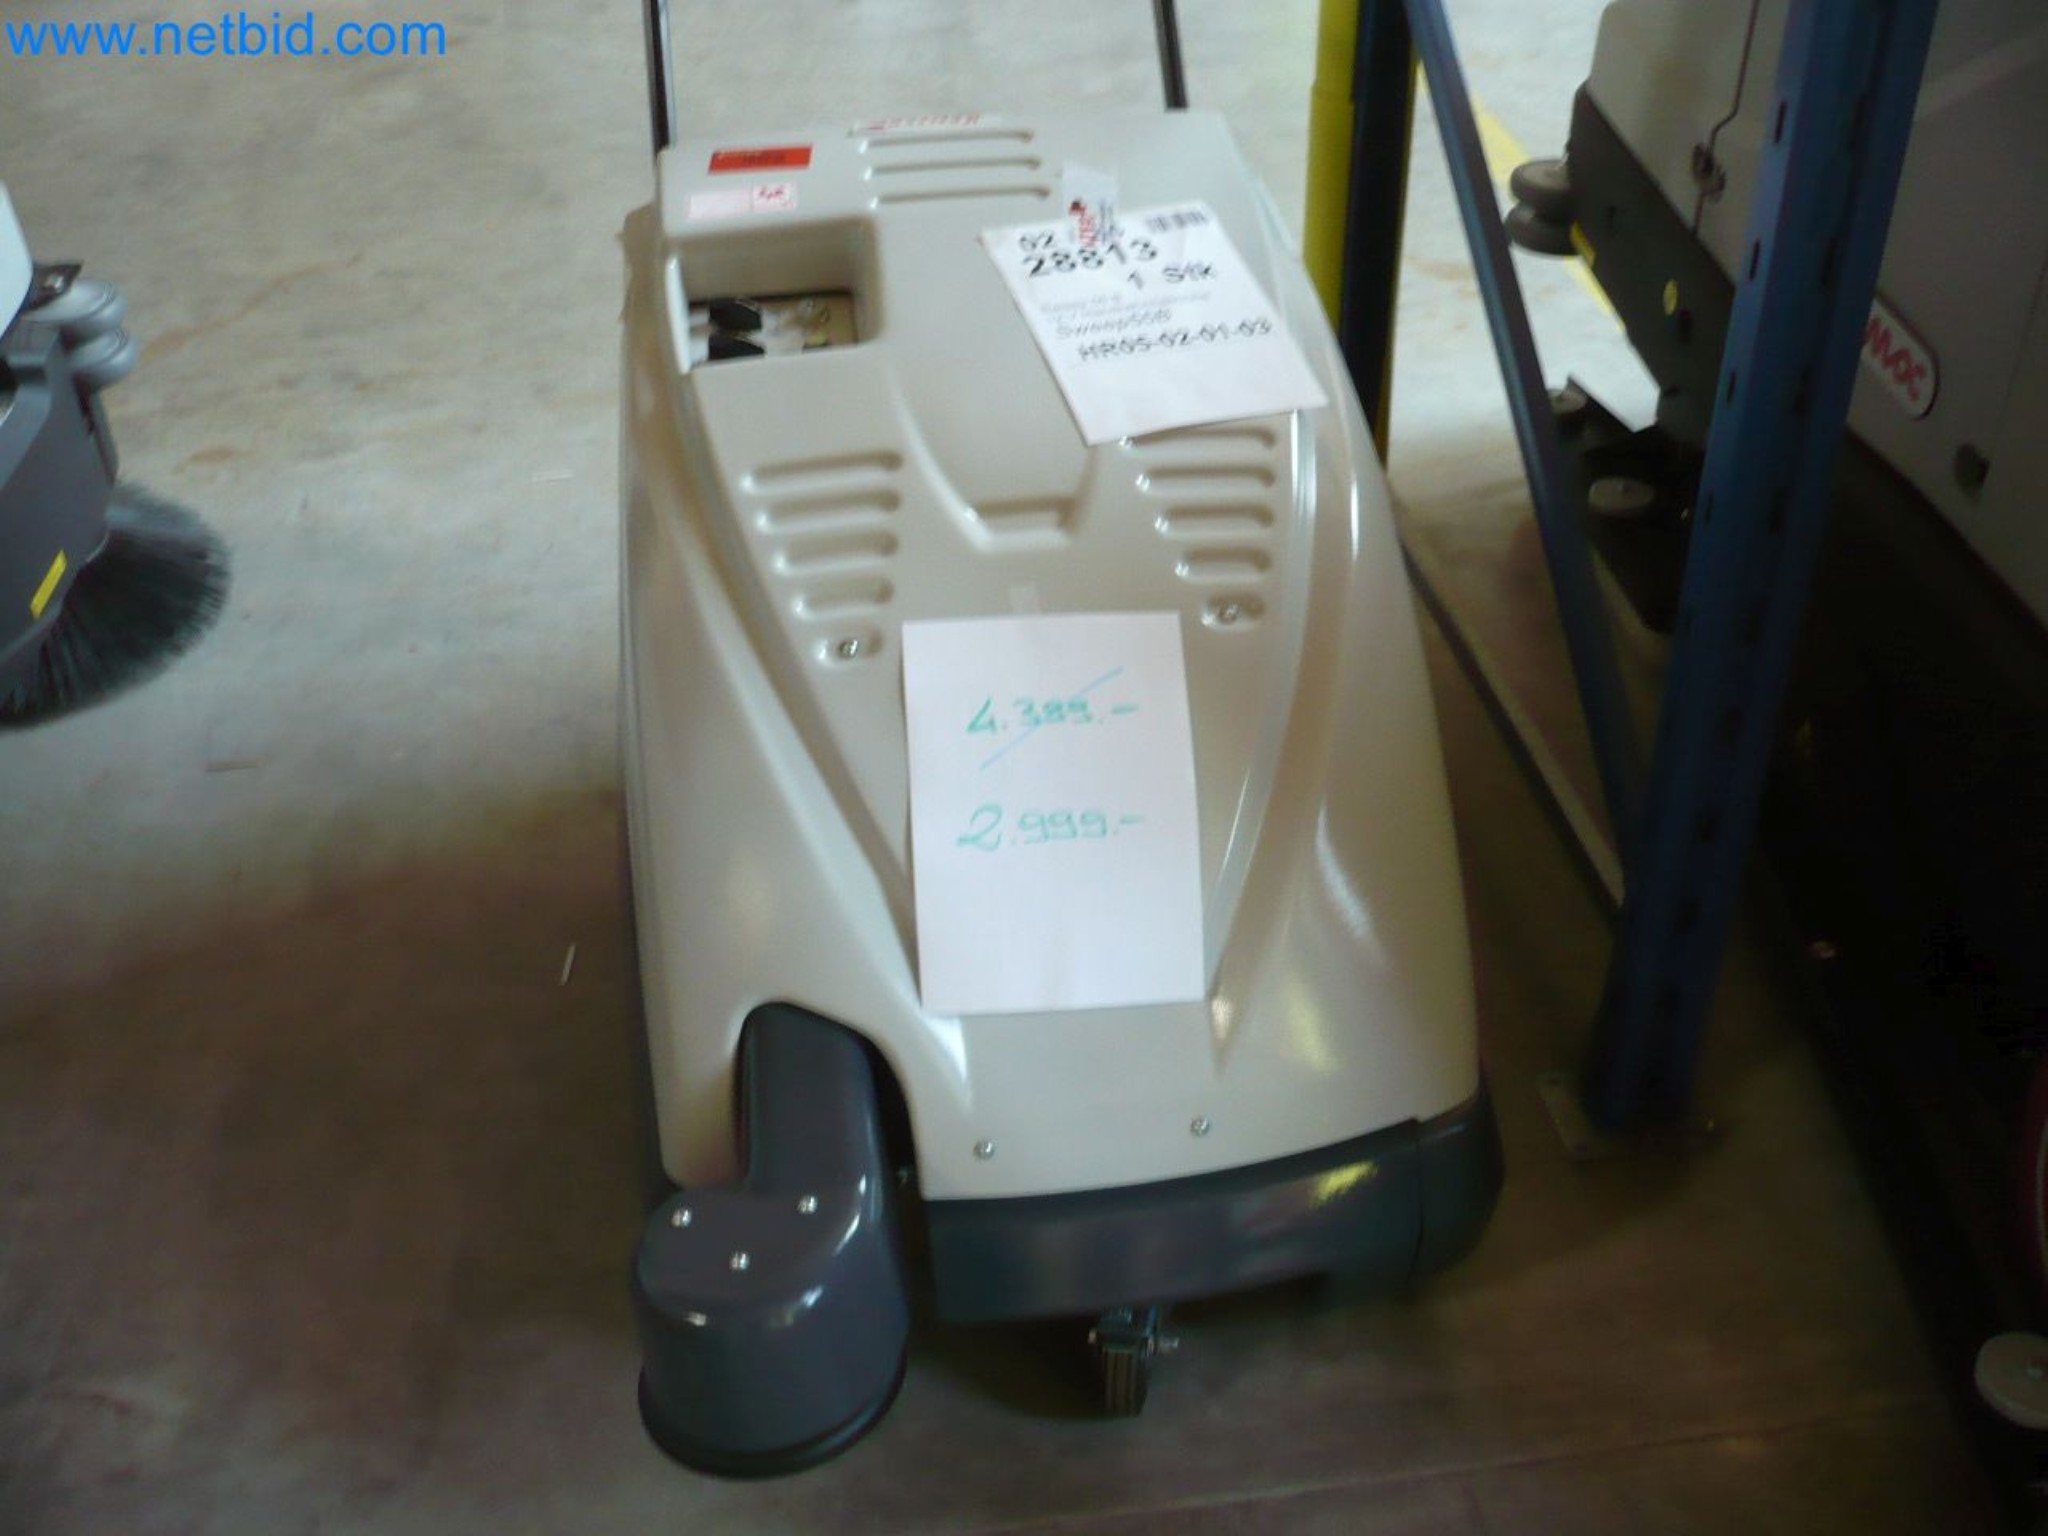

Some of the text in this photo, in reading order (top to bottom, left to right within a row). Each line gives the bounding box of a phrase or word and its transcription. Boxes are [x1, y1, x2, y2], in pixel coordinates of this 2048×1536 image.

[1022, 238, 1158, 278] 28813
[1127, 263, 1217, 291] 1 Stk
[1077, 318, 1274, 362] HR05-02-01-03
[956, 803, 1145, 852] 2.999.-
